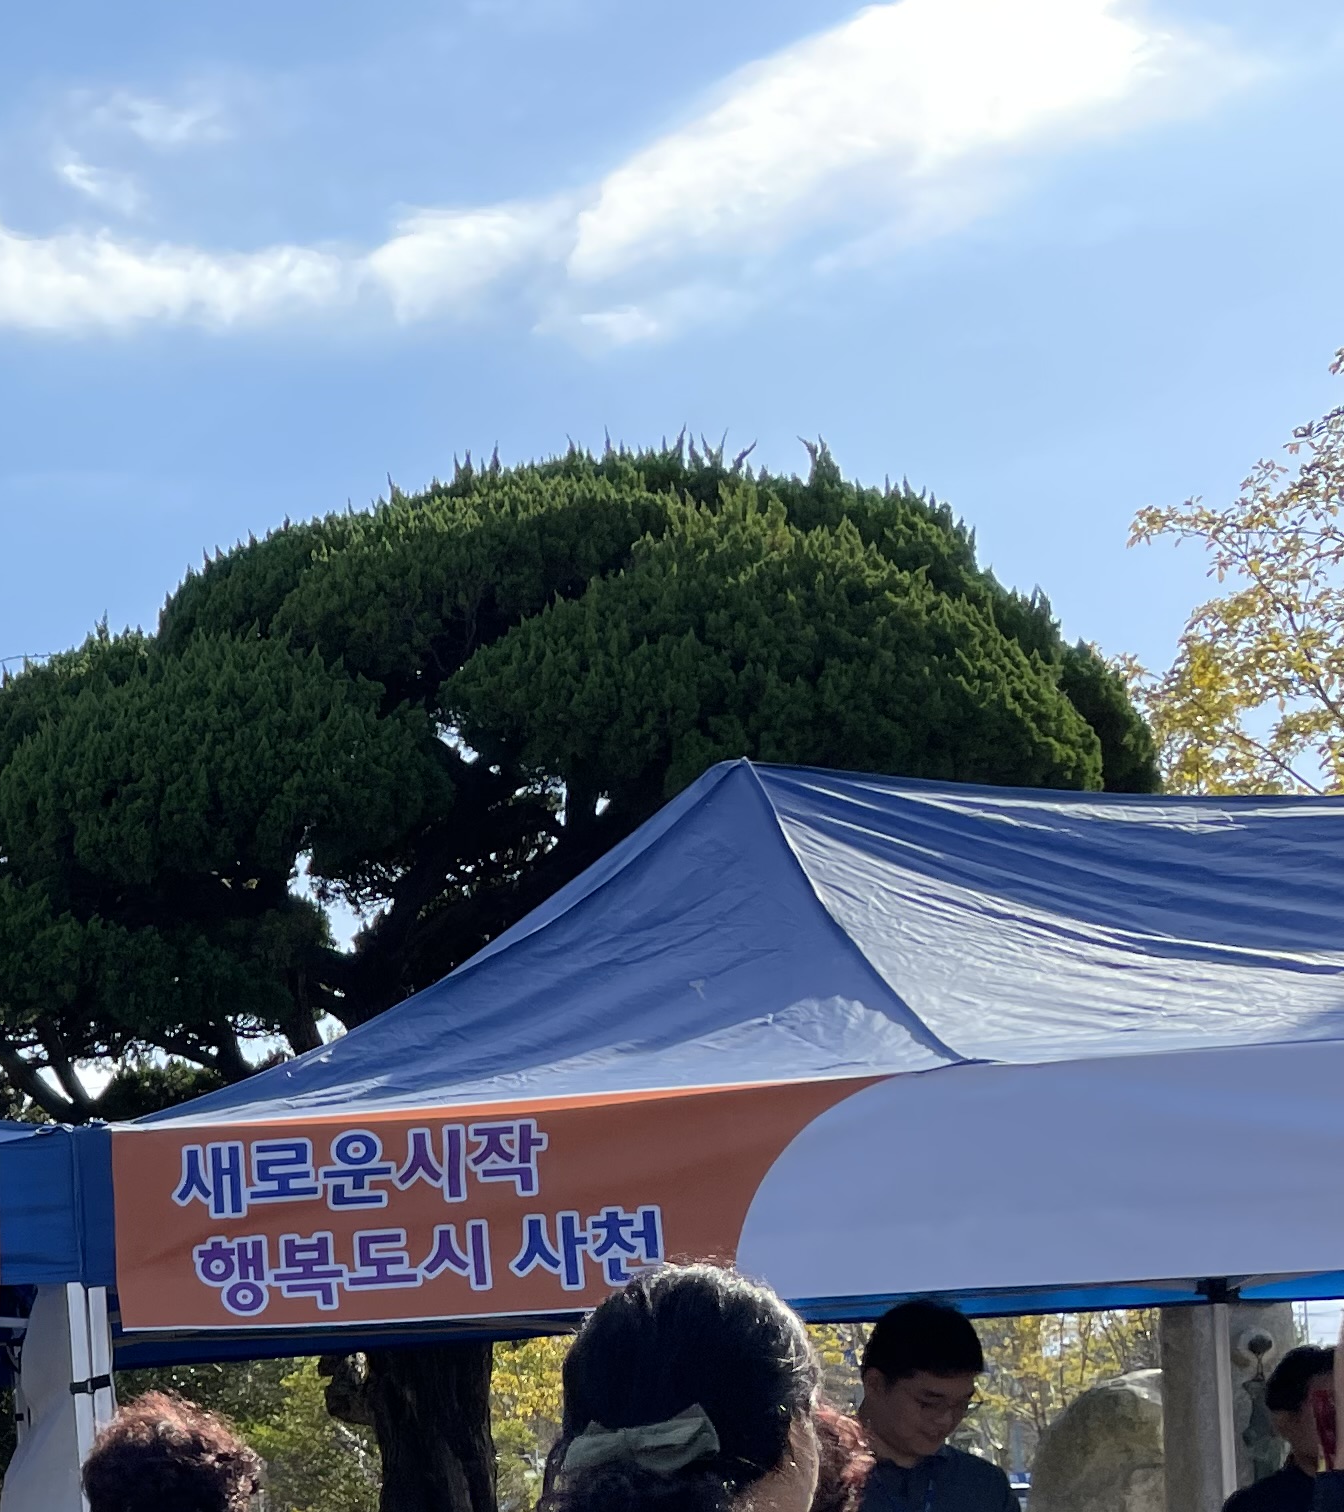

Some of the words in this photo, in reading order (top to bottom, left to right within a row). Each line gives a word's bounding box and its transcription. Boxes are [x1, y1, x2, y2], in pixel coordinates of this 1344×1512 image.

[173, 1119, 547, 1218] 새로운시작
[195, 1217, 492, 1316] 행복도시
[510, 1205, 664, 1290] 사천
